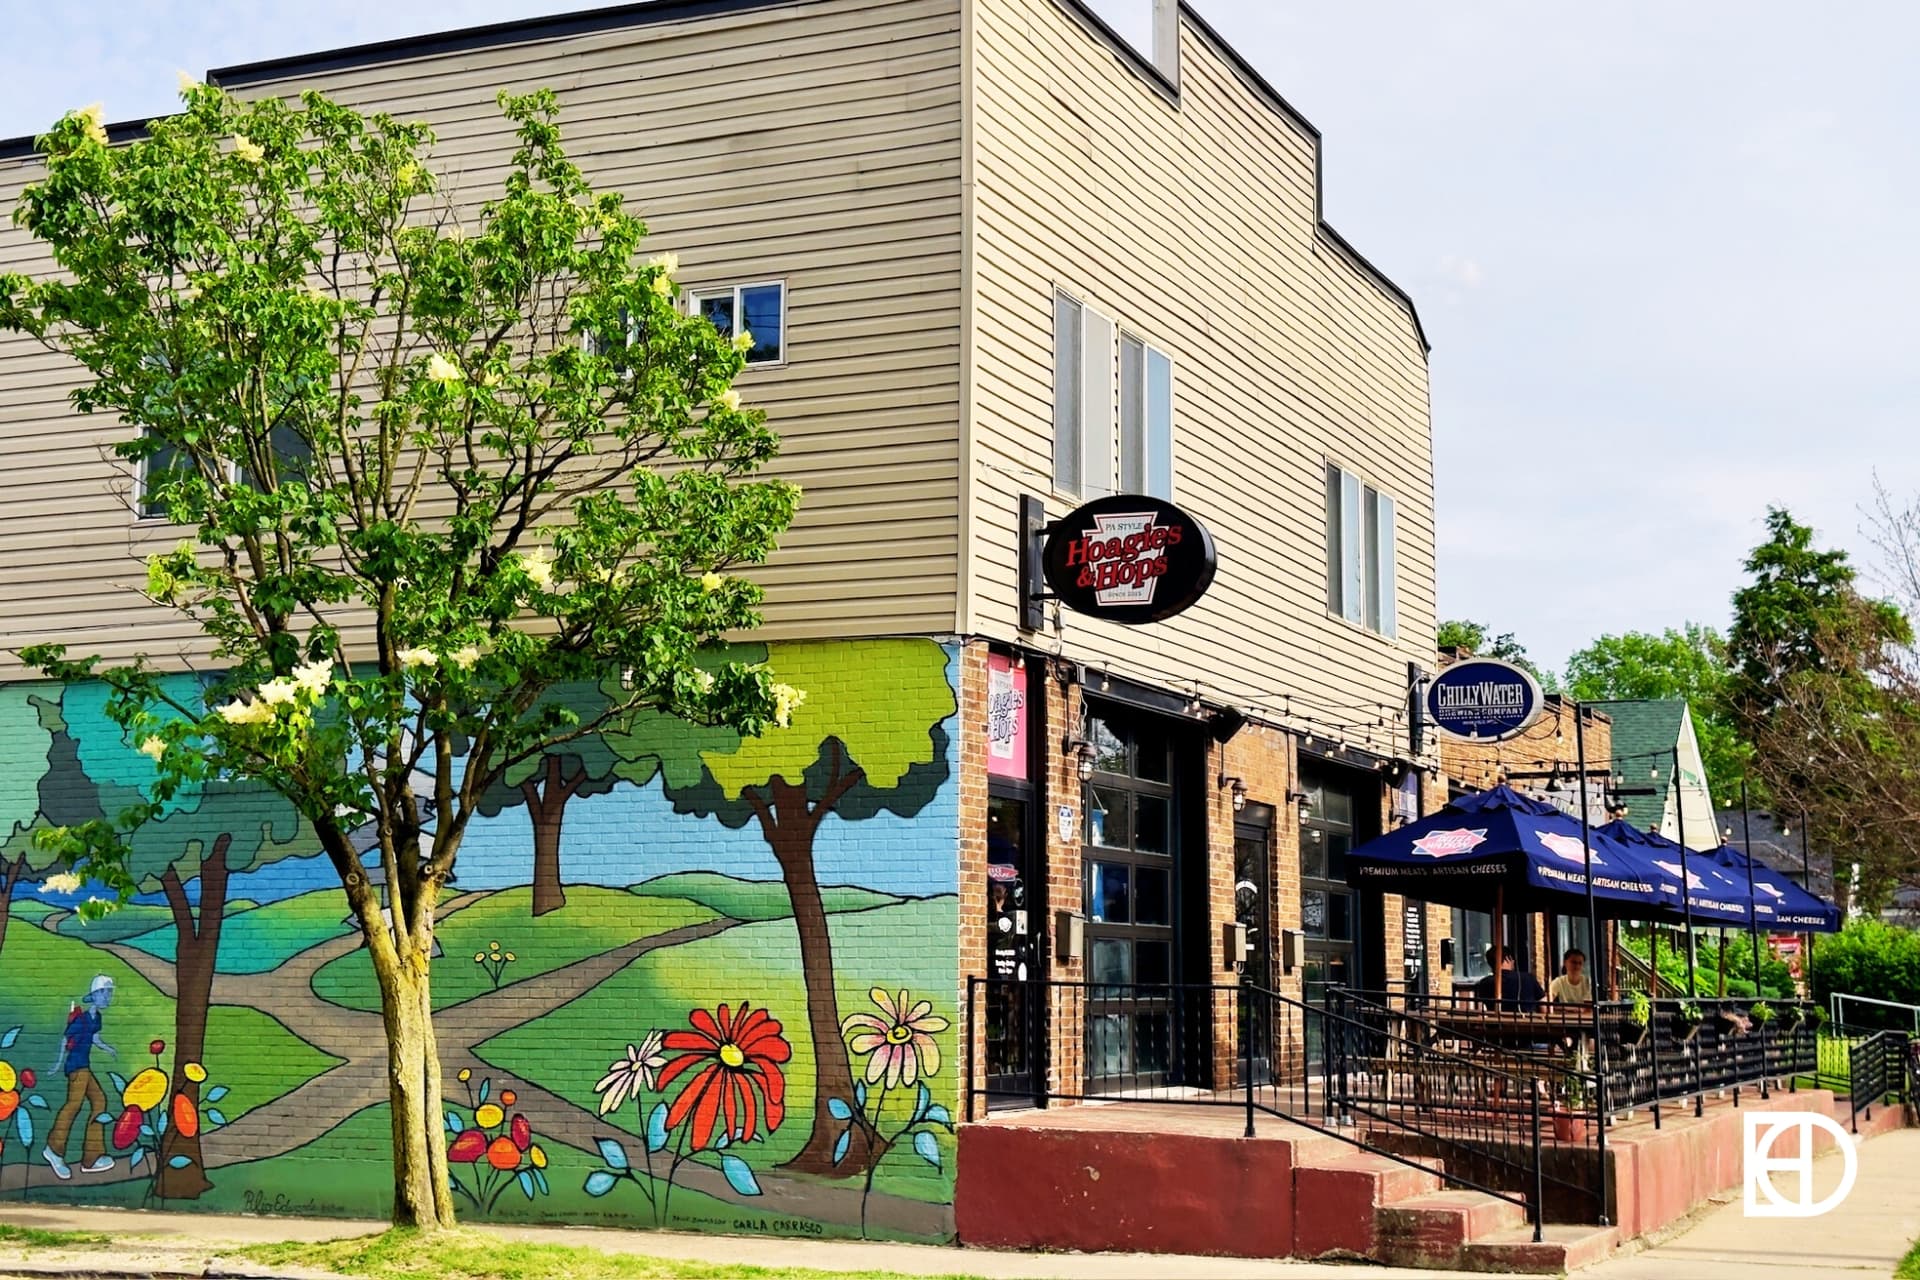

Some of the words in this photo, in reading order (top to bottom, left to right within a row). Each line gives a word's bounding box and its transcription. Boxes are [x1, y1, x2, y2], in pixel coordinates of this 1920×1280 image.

[1105, 523, 1117, 531] PA
[1117, 522, 1144, 531] STYLE
[1065, 523, 1183, 567] Hoagies
[1438, 708, 1480, 717] BREWING
[1481, 706, 1524, 715] COMPANY
[1359, 866, 1399, 876] PREMIUM
[1432, 866, 1470, 876] ARTISAN
[1470, 864, 1508, 875] CHEESES
[1592, 878, 1620, 889] ARTISAN
[1792, 916, 1826, 926] CHEESES
[732, 1219, 769, 1232] CARLA
